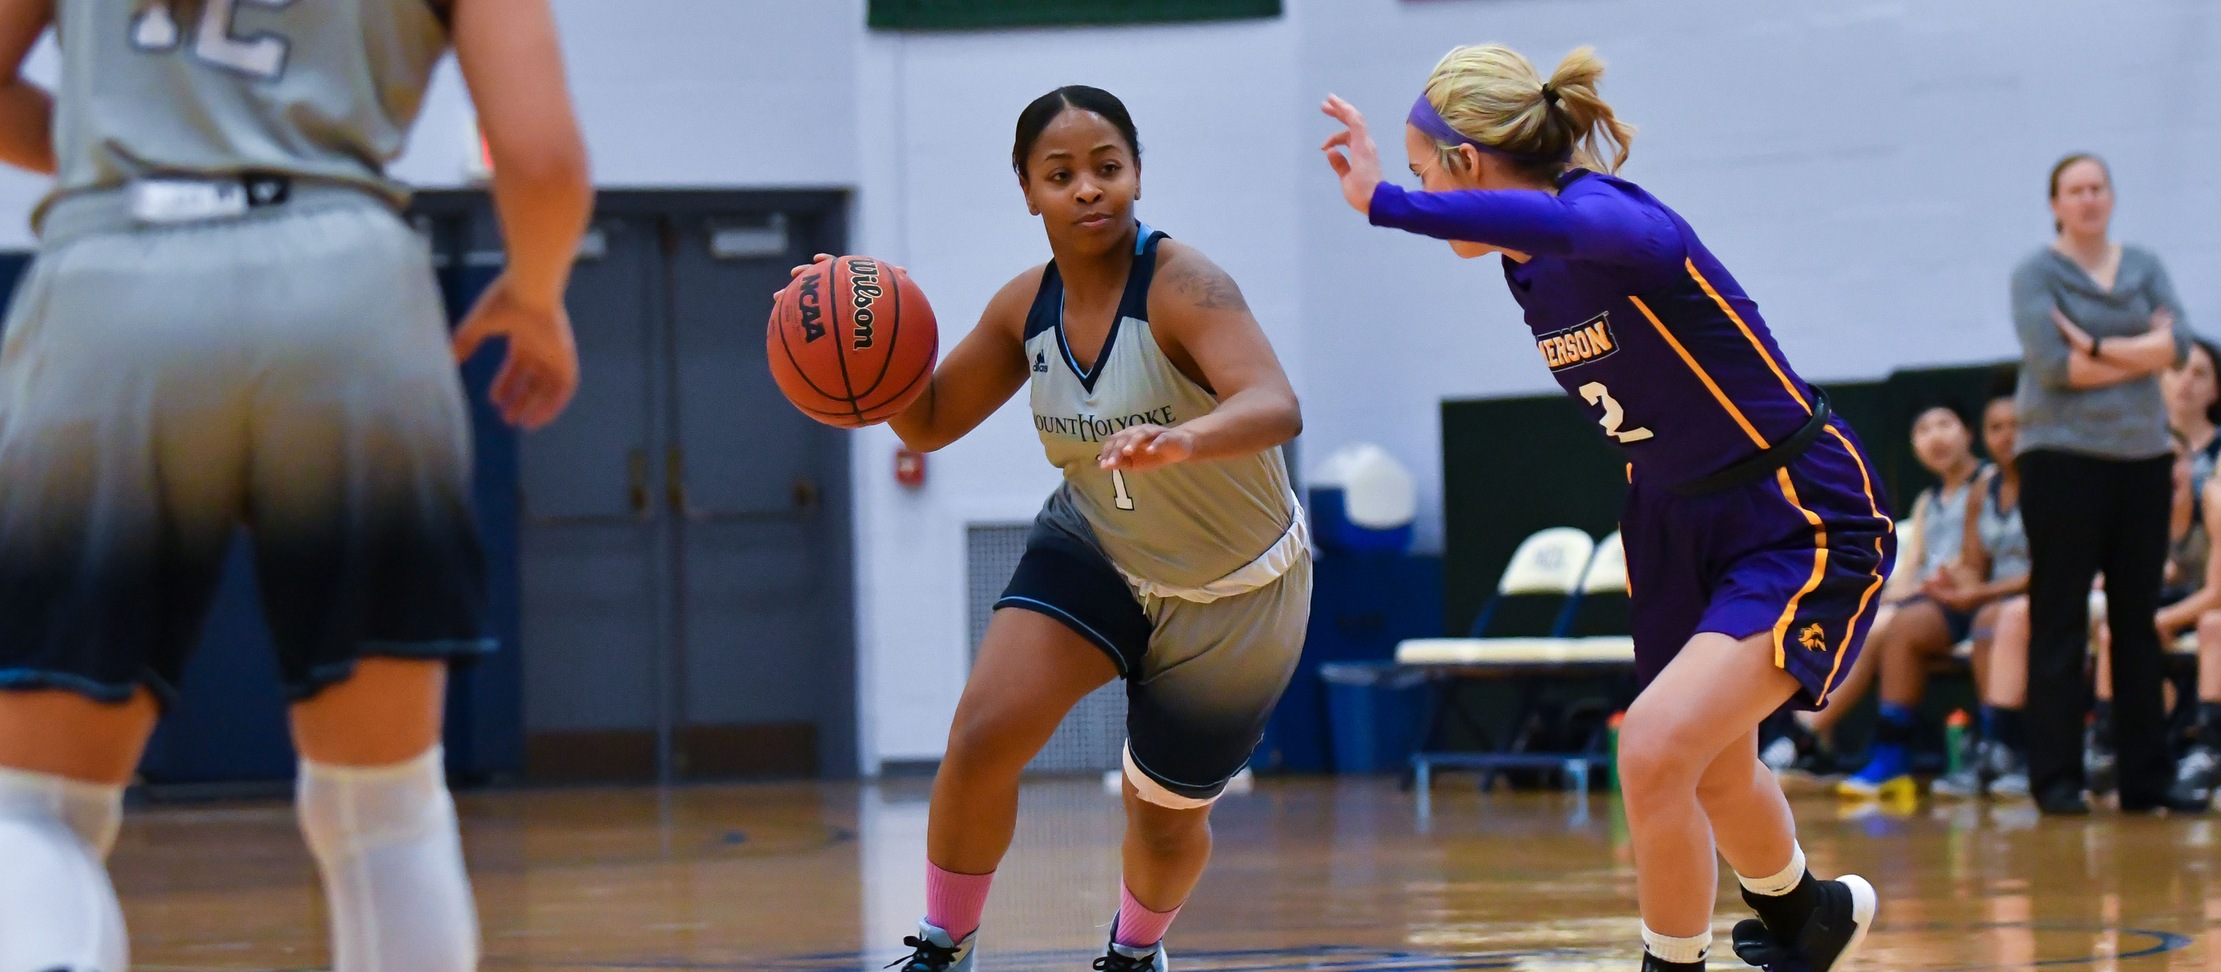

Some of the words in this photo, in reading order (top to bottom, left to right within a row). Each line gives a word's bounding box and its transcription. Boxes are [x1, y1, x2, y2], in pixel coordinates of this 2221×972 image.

[799, 273, 826, 344] NCAA
[846, 258, 884, 351] Wilson
[1034, 414, 1077, 434] OUNT
[1578, 381, 1654, 443] 2
[1102, 457, 1135, 511] 1
